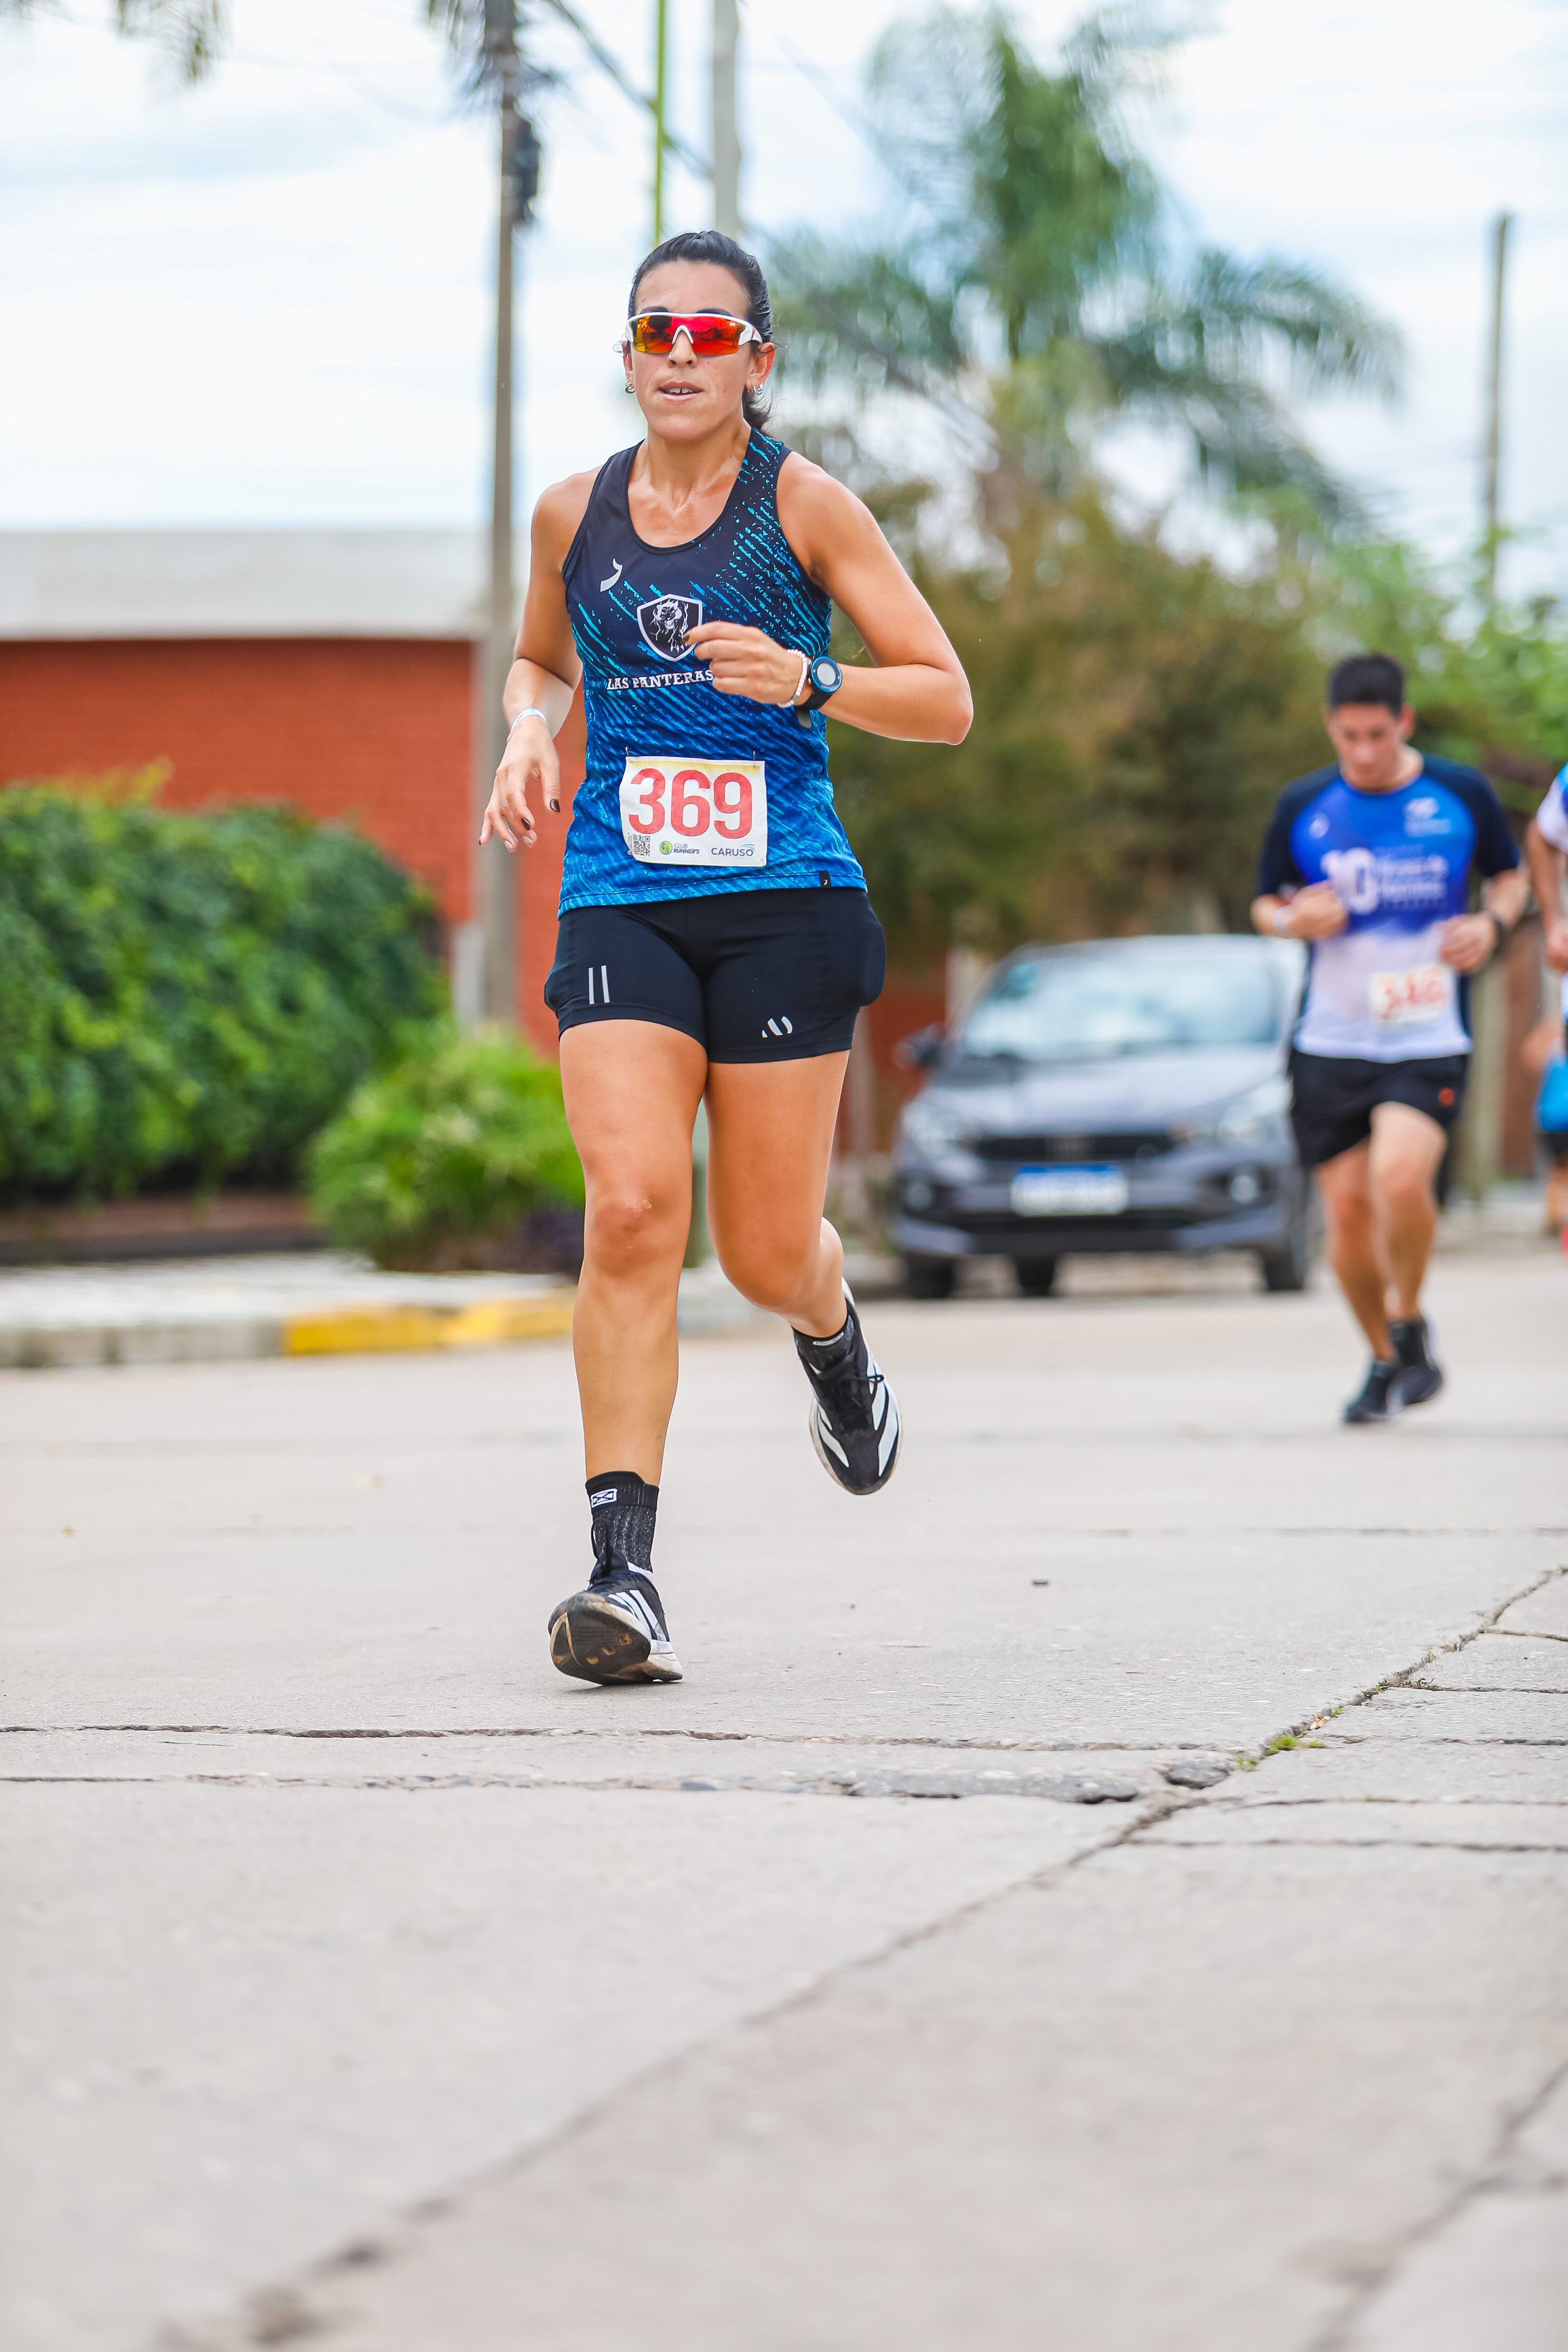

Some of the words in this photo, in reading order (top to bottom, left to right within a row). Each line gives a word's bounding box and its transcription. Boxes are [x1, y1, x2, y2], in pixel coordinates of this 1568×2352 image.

[607, 677, 629, 690] LAS
[632, 669, 714, 688] PANTERAS
[629, 768, 752, 839] 369
[711, 847, 753, 856] CARUSO
